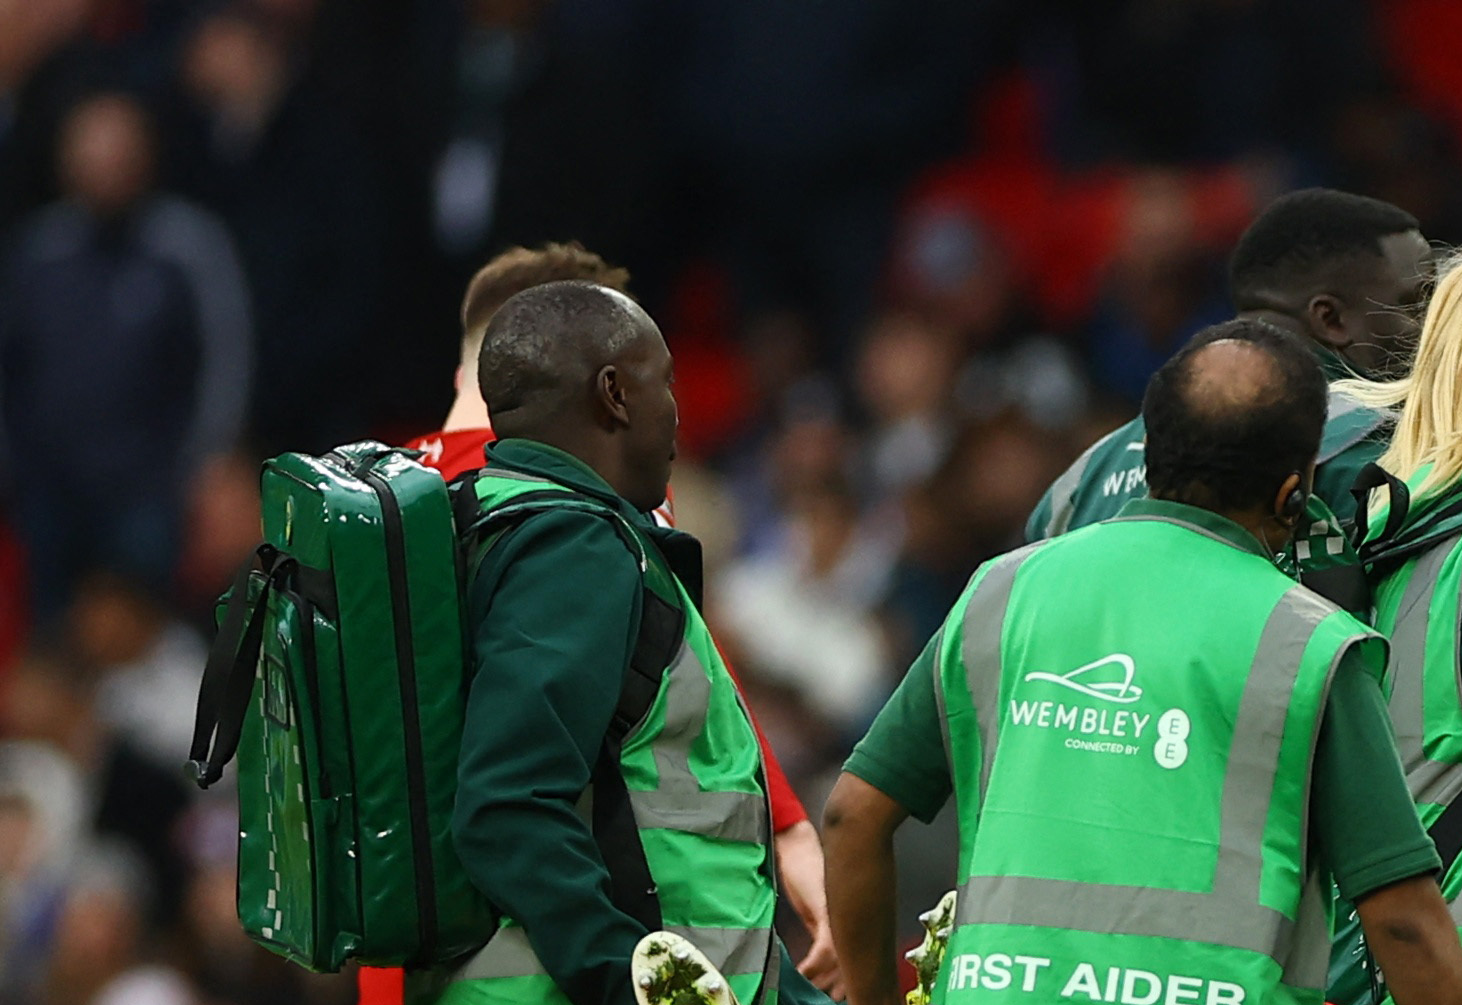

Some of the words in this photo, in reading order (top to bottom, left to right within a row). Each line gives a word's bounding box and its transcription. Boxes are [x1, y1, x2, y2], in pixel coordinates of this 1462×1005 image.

[1010, 700, 1150, 738] WEMBLEY
[1064, 738, 1124, 754] CONNECTED
[1124, 745, 1140, 755] BY
